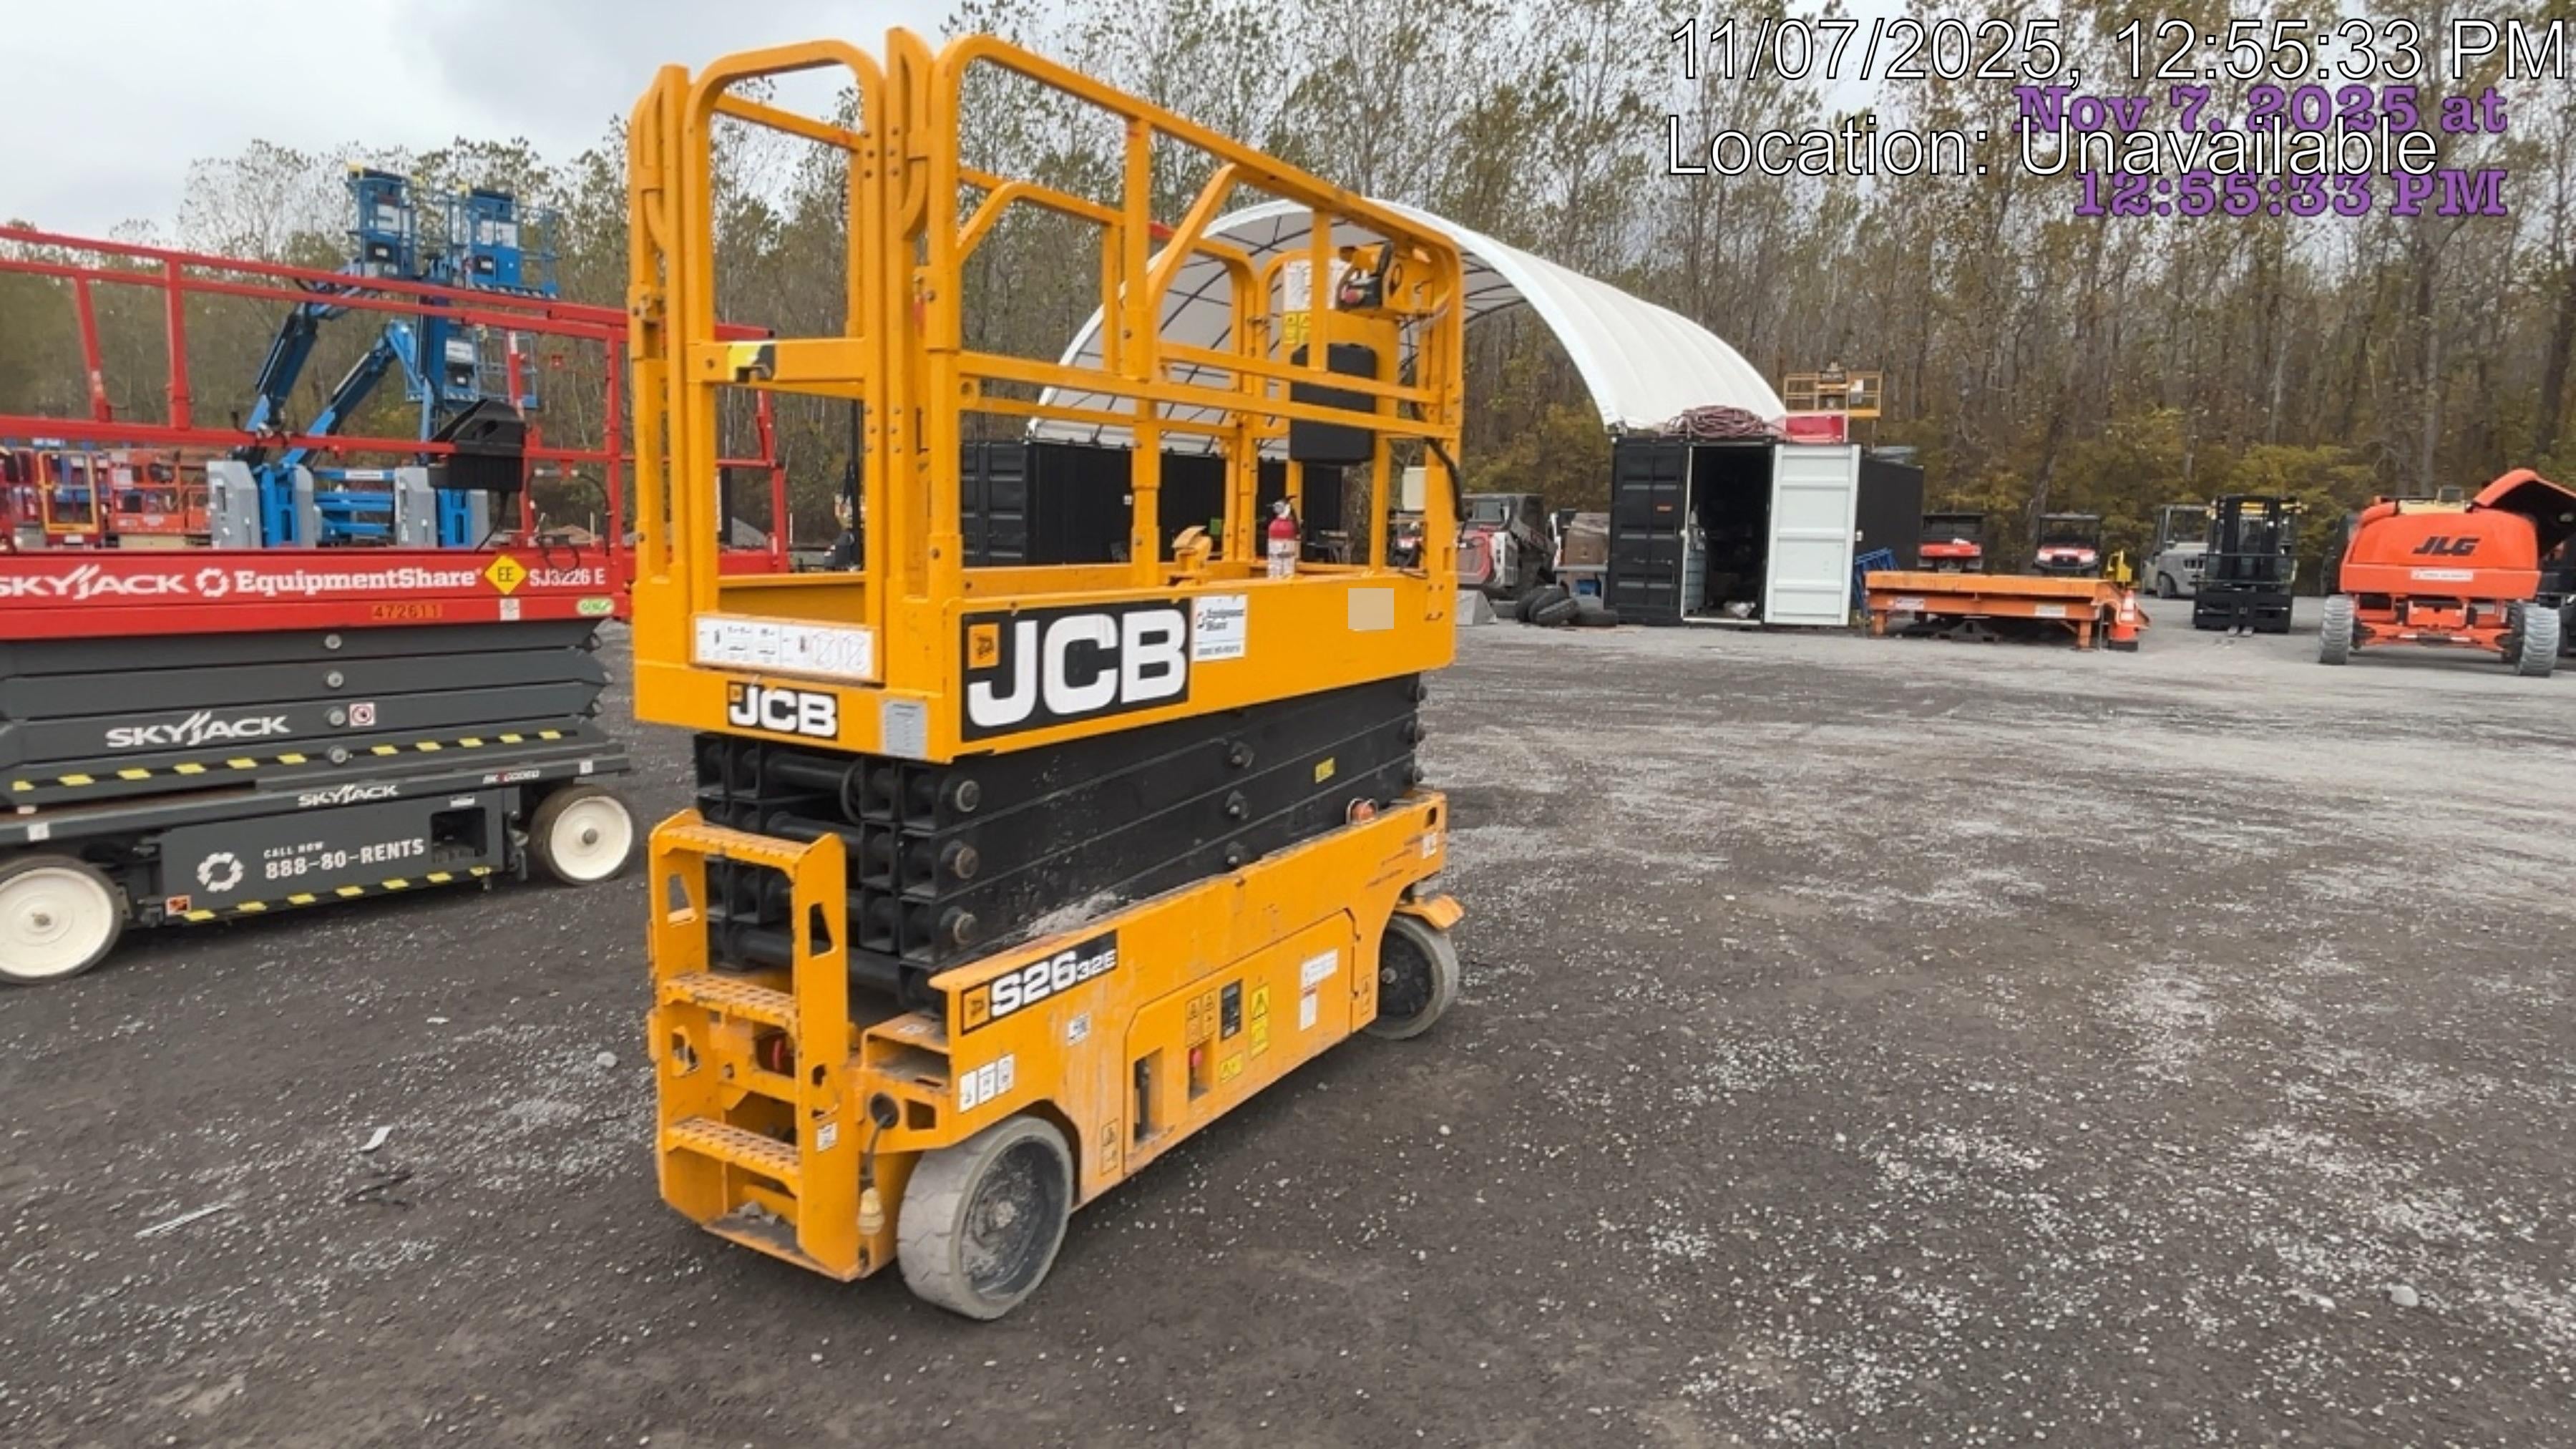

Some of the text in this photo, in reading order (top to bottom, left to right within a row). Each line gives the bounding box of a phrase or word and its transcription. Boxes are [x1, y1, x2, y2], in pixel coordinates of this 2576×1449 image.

[2412, 536, 2481, 556] JLG
[235, 568, 477, 597] EquipmentShare
[497, 566, 514, 582] EE
[529, 567, 606, 587] SJ3226 E
[373, 605, 439, 619] 472611
[967, 609, 1186, 728] JCB
[728, 685, 838, 737] JCB
[105, 711, 291, 748] SKYJACK
[298, 784, 399, 808] SKYJACK
[263, 846, 293, 859] CALL
[265, 838, 425, 880] 888-80-RENTS
[990, 950, 1077, 1018] S26
